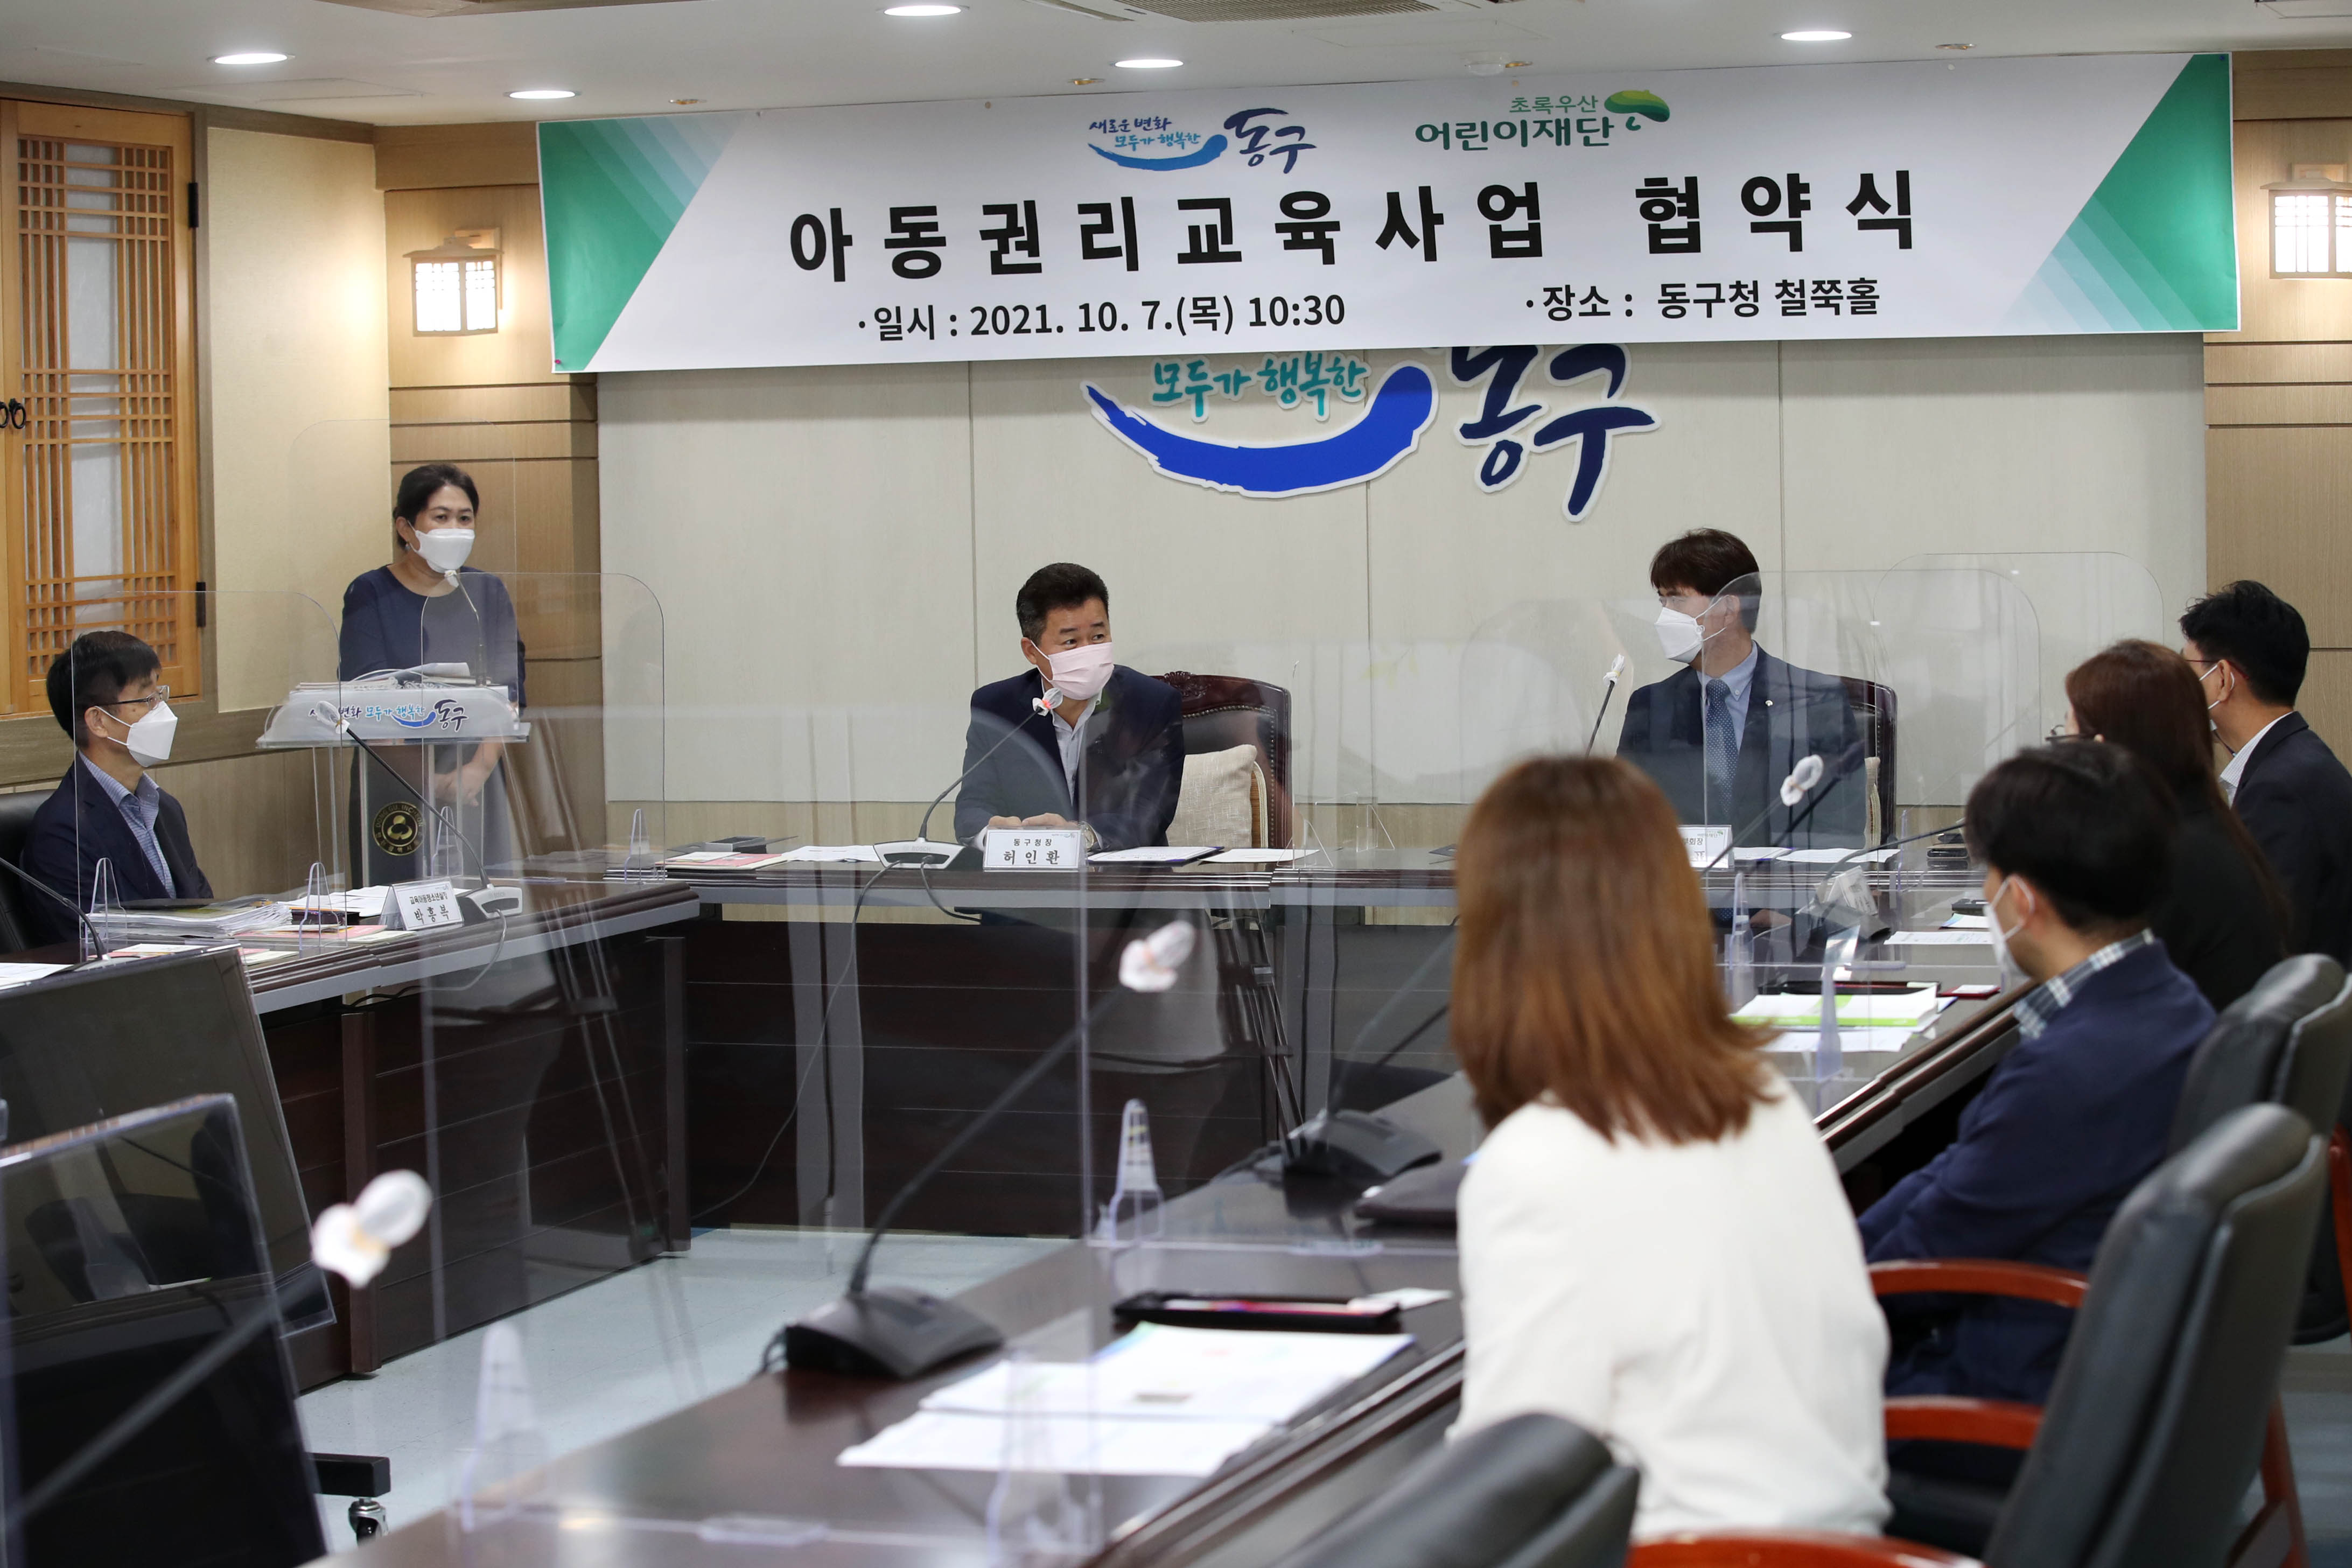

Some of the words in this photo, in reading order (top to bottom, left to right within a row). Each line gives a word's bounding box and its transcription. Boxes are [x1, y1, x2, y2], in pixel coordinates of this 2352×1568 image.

[1509, 95, 1598, 114] 초록우산
[1089, 118, 1131, 133] 새로운
[1133, 116, 1172, 131] 변화
[1115, 134, 1154, 151] 모두가
[1158, 131, 1201, 150] 행복한
[1223, 107, 1317, 174] 동구
[1415, 116, 1614, 151] 어린이재단
[790, 181, 1543, 282] 아동권리교육사업
[1635, 170, 1913, 255] 협약식
[1657, 280, 1760, 319] 동구청
[1775, 277, 1880, 317] 철쭉홀
[970, 304, 1063, 335] 2021.
[1079, 301, 1129, 332] 10.
[1142, 294, 1234, 336] 7.(목)
[1249, 294, 1345, 327] 10:30
[1152, 359, 1251, 417] 모두가
[1257, 351, 1367, 416] 행복한
[340, 705, 362, 719] 변화
[366, 706, 393, 720] 모두가
[396, 705, 425, 720] 행복한
[434, 699, 467, 731] 동구
[1004, 850, 1060, 865] 허인환
[1013, 838, 1052, 847] 동구청장
